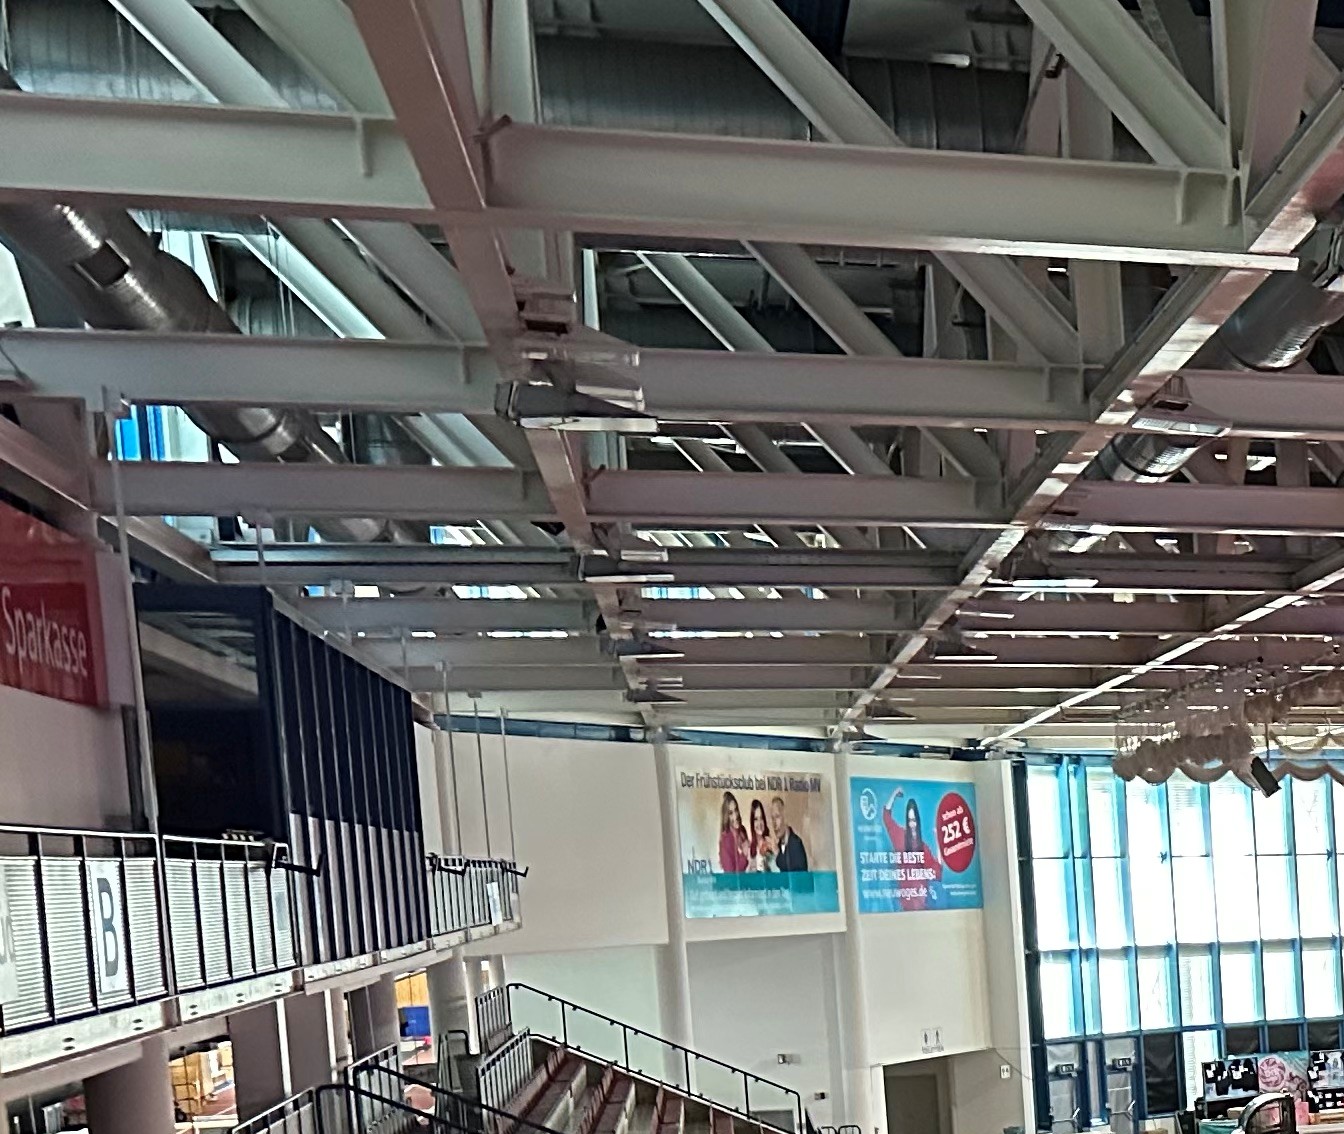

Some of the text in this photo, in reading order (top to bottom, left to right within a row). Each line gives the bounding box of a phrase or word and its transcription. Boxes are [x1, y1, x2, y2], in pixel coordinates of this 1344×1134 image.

[2, 585, 88, 677] Sparkasse
[681, 771, 694, 788] Der
[755, 775, 766, 791] bei
[767, 776, 782, 792] NDR
[941, 816, 971, 844] 252 €
[97, 877, 119, 977] B
